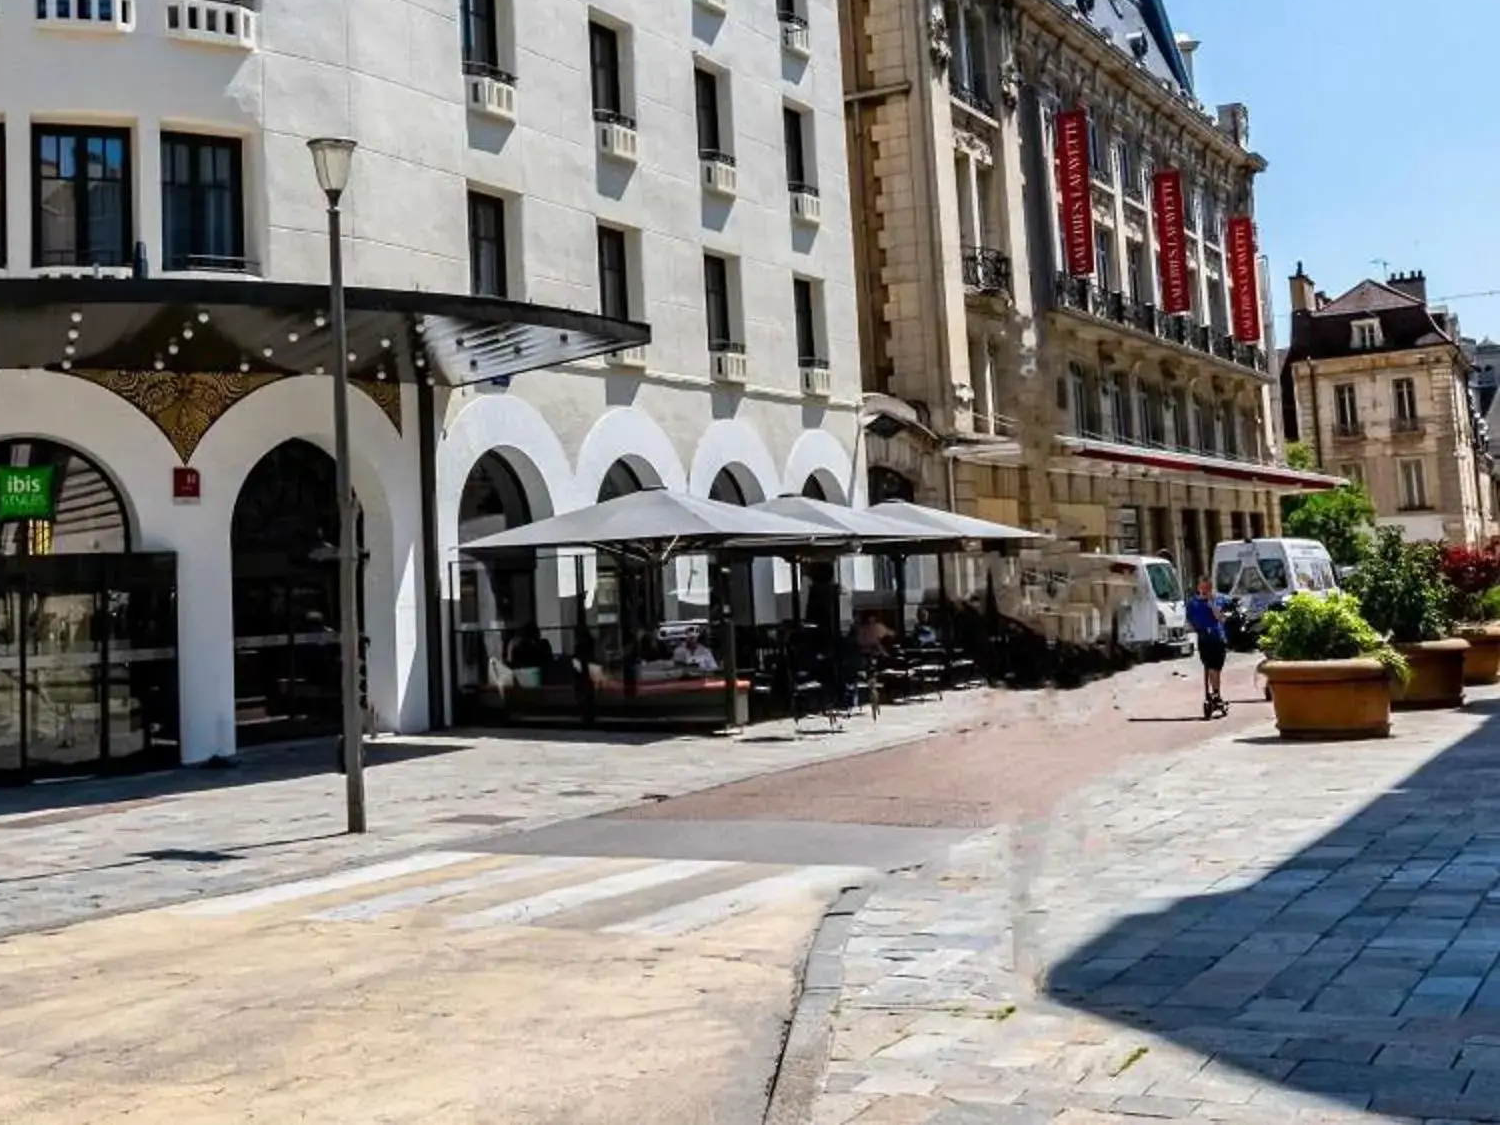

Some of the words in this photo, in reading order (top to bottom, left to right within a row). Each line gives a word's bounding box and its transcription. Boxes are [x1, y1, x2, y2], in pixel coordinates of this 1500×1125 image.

[1064, 117, 1083, 198] LAFAYETTE
[1070, 201, 1087, 272] GALERIES
[7, 474, 41, 493] ibis
